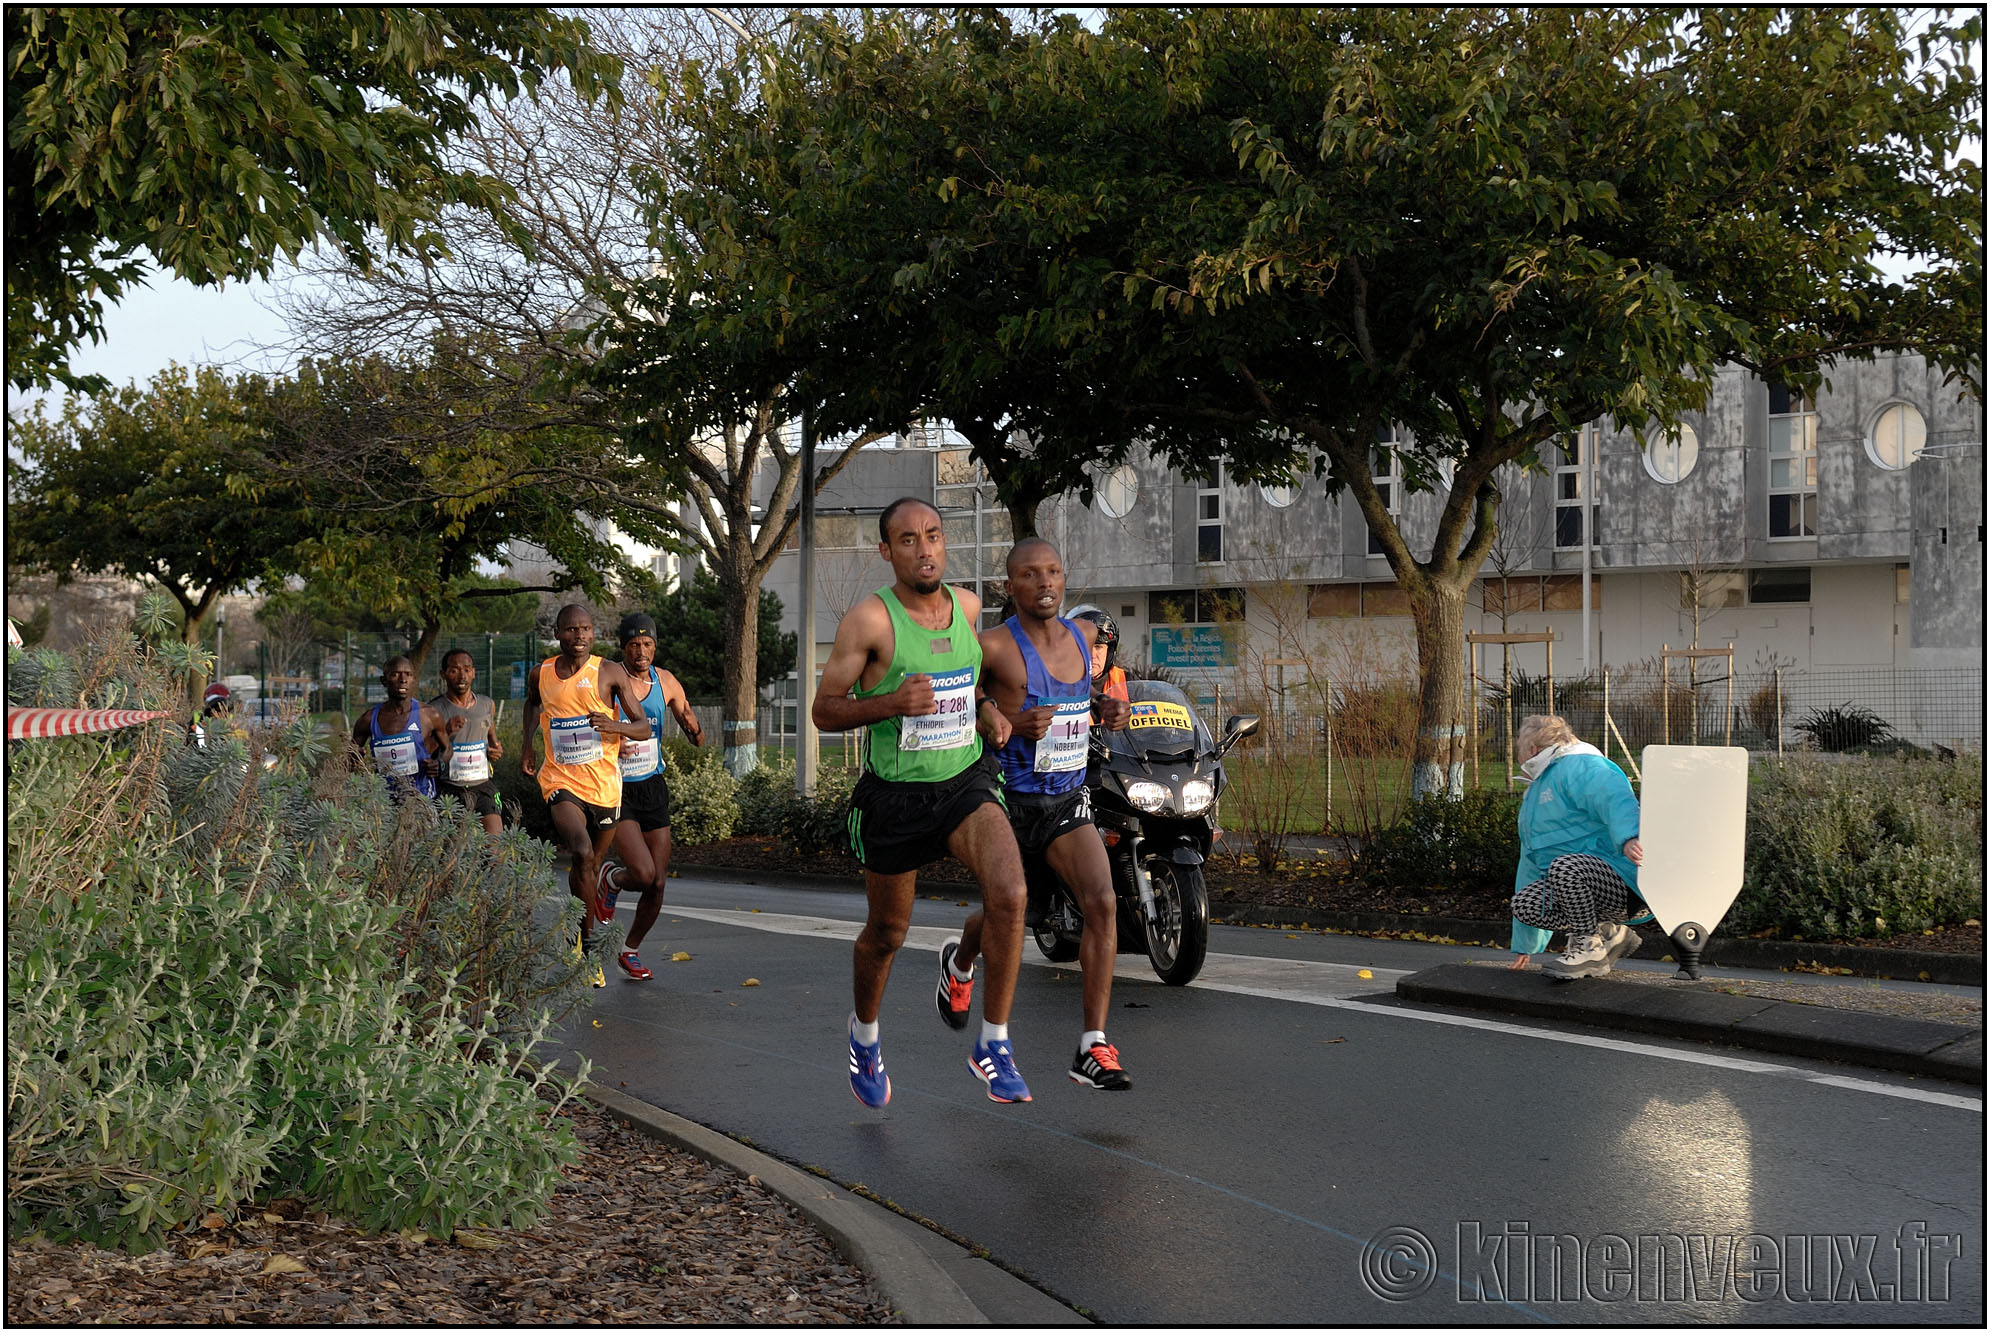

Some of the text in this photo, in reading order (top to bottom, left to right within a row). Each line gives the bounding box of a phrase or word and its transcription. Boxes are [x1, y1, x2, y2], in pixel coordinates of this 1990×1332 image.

[950, 695, 969, 713] 28K
[1163, 708, 1184, 716] MEDIA
[916, 720, 944, 729] ETHIOPIE
[958, 713, 967, 728] 15
[1131, 717, 1191, 729] OFFICIEL
[921, 729, 961, 742] MARATHON
[1065, 720, 1079, 740] 14
[381, 735, 412, 745] BROOKS
[572, 732, 578, 745] 1
[460, 743, 485, 751] BROOKS
[1054, 742, 1077, 752] NOBERT
[390, 748, 397, 760] 6
[467, 754, 473, 765] 4
